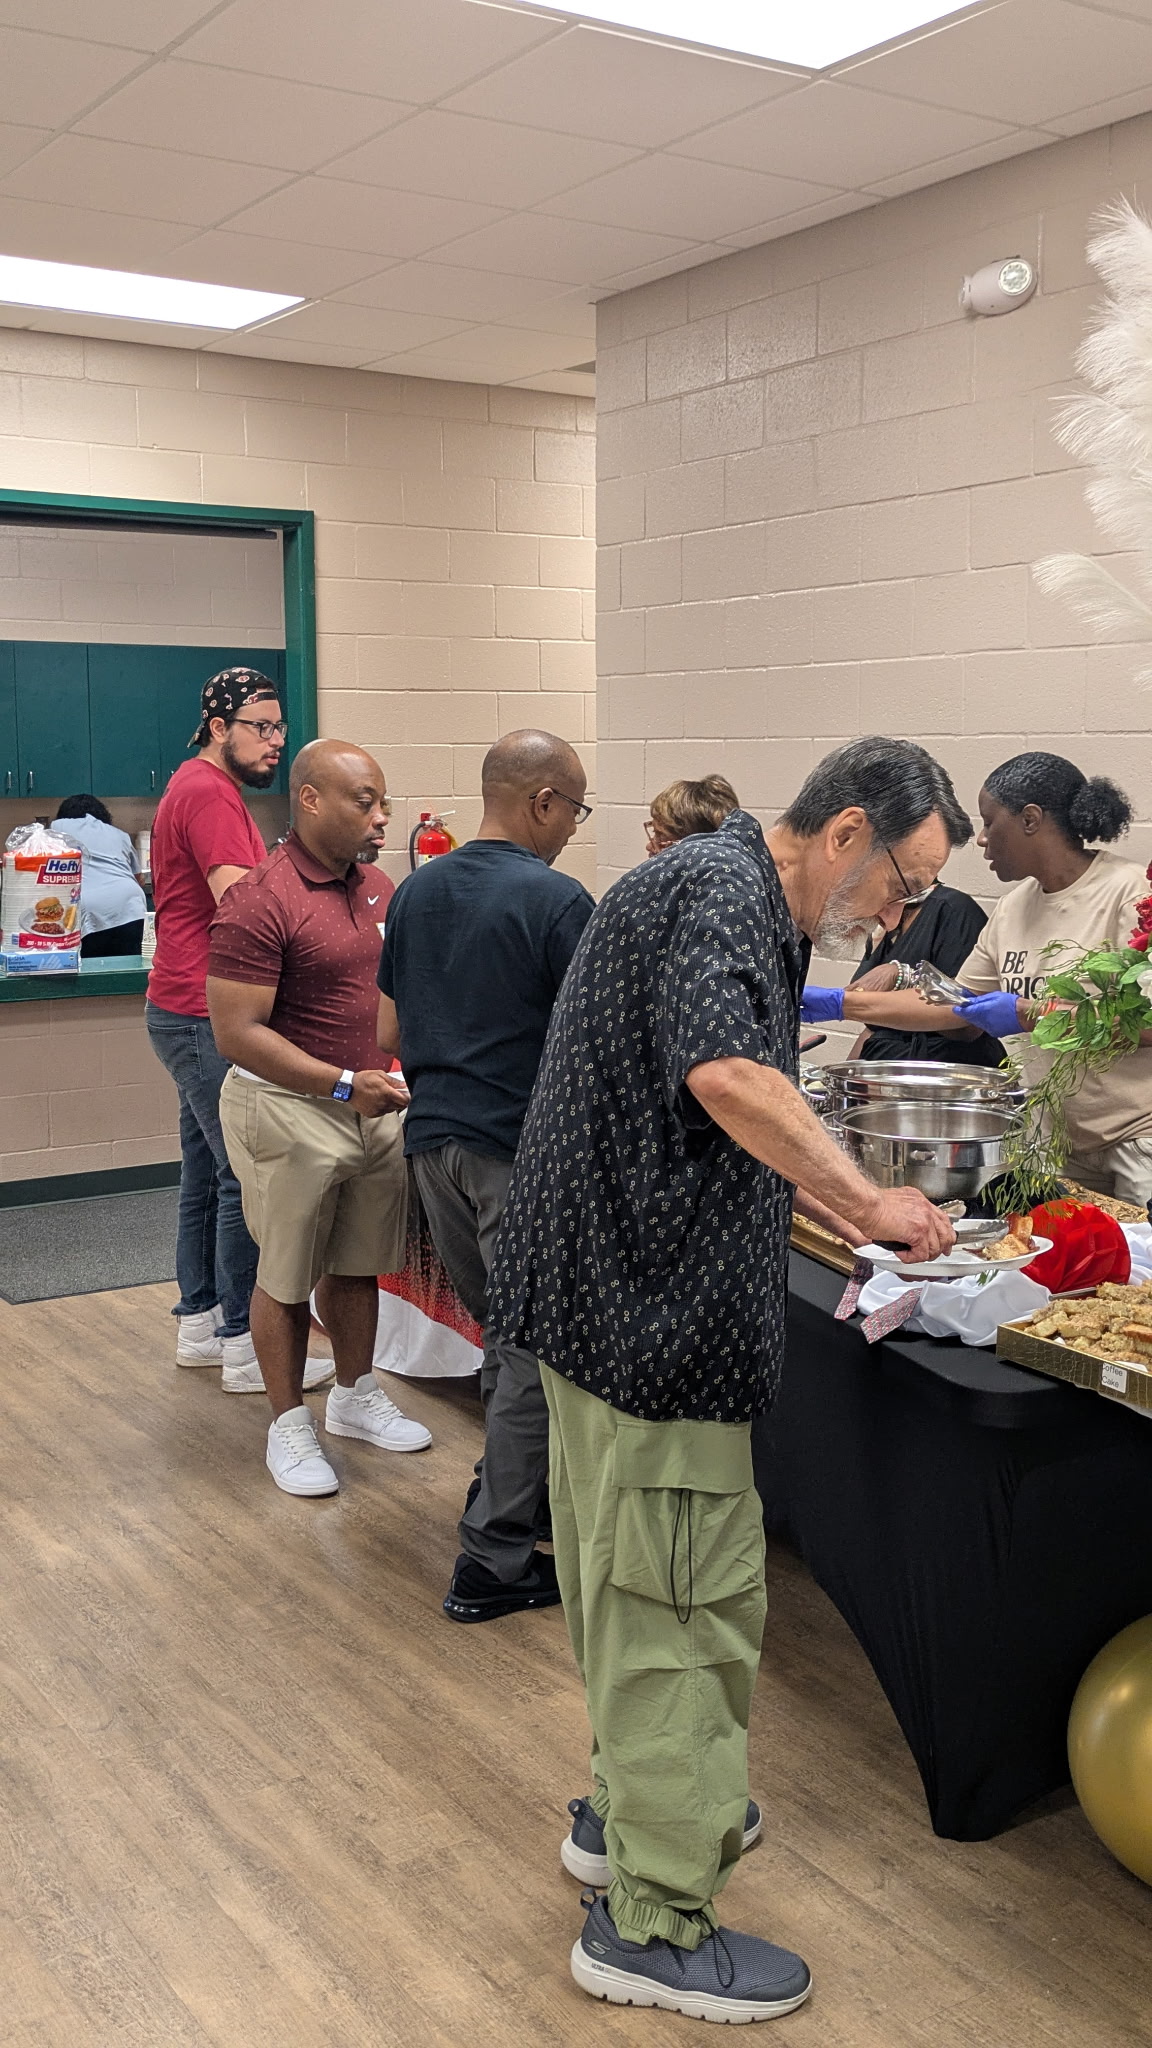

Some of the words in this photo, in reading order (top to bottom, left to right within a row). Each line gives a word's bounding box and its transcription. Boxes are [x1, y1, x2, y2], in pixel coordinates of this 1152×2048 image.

[48, 860, 80, 872] Hefty
[43, 875, 80, 883] SUPREME
[1001, 950, 1028, 974] BE
[1102, 1375, 1119, 1388] Cake
